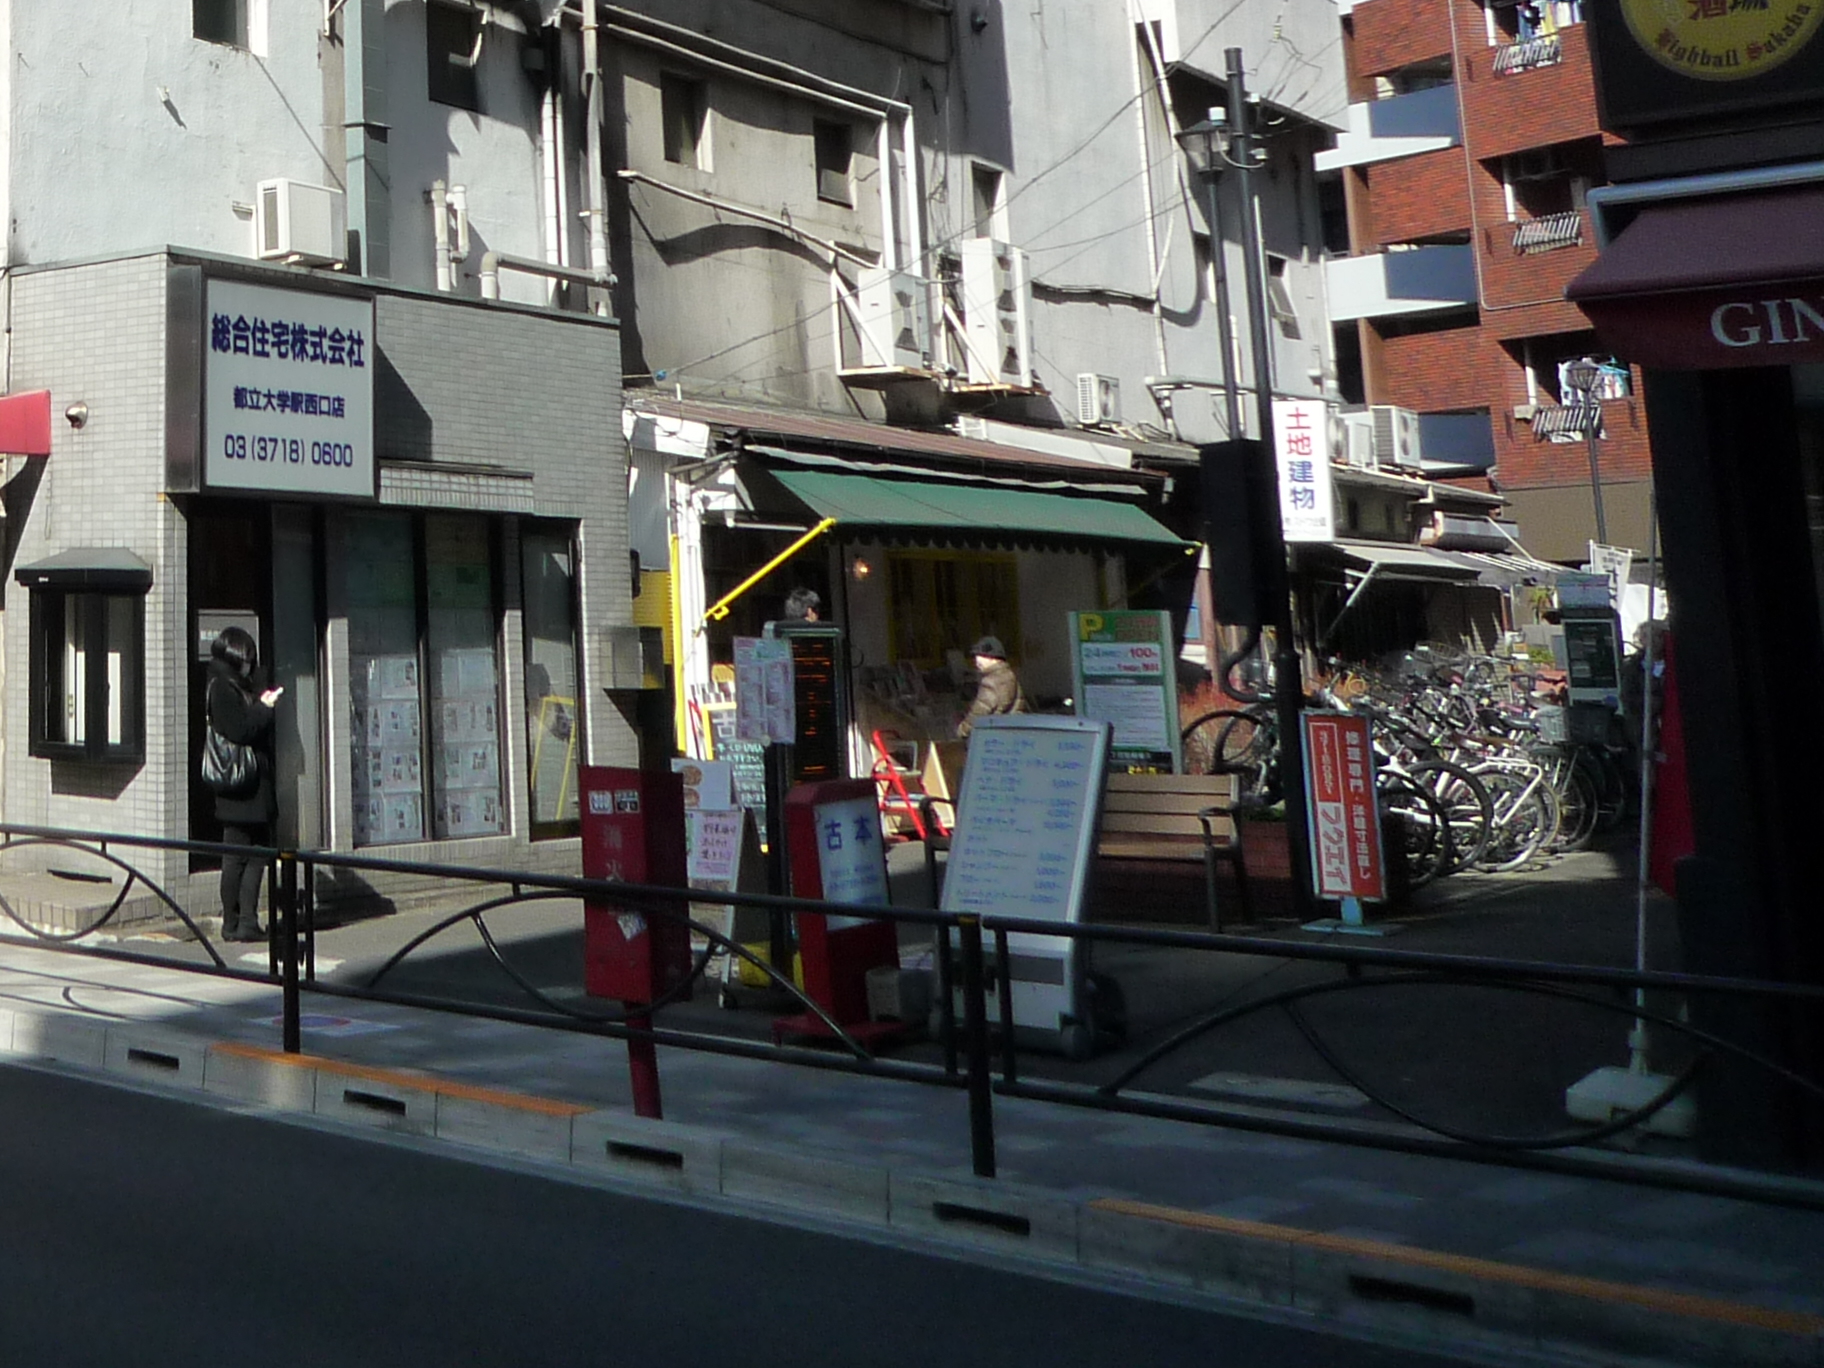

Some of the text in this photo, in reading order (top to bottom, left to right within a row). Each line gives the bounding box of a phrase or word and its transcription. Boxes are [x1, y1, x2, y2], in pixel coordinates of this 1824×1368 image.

[211, 312, 365, 368] 総合住宅株式会社
[233, 385, 345, 418] 都立大学駅西口店
[225, 434, 353, 467] 03 (3718) 0600
[1285, 406, 1315, 511] 土地建物
